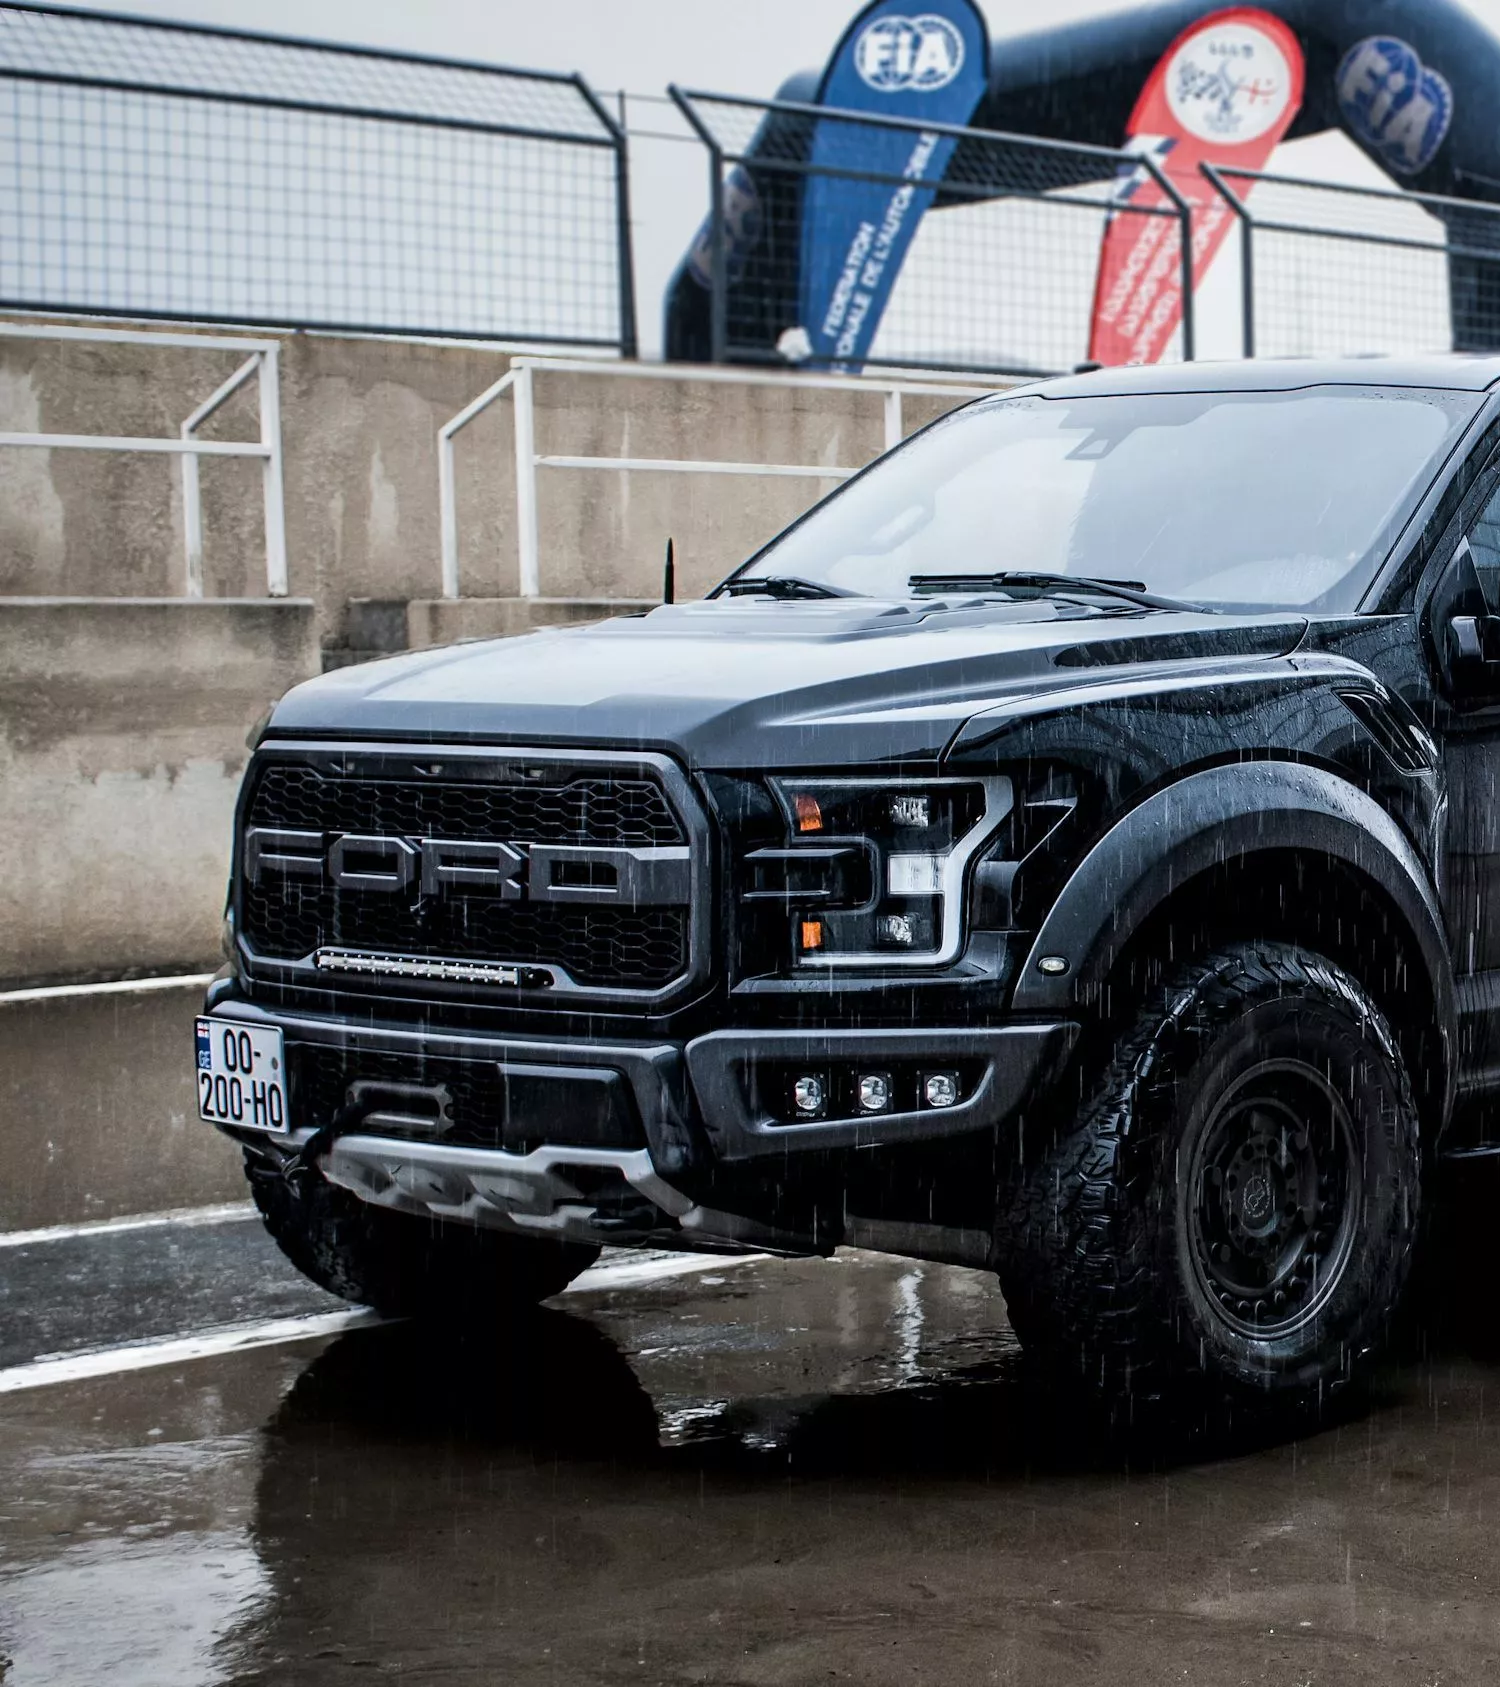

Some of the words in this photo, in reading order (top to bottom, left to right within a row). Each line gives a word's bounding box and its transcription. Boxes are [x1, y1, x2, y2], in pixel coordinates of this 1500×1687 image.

[862, 30, 952, 76] FIA
[1341, 47, 1438, 164] FIA
[246, 827, 645, 904] FORD
